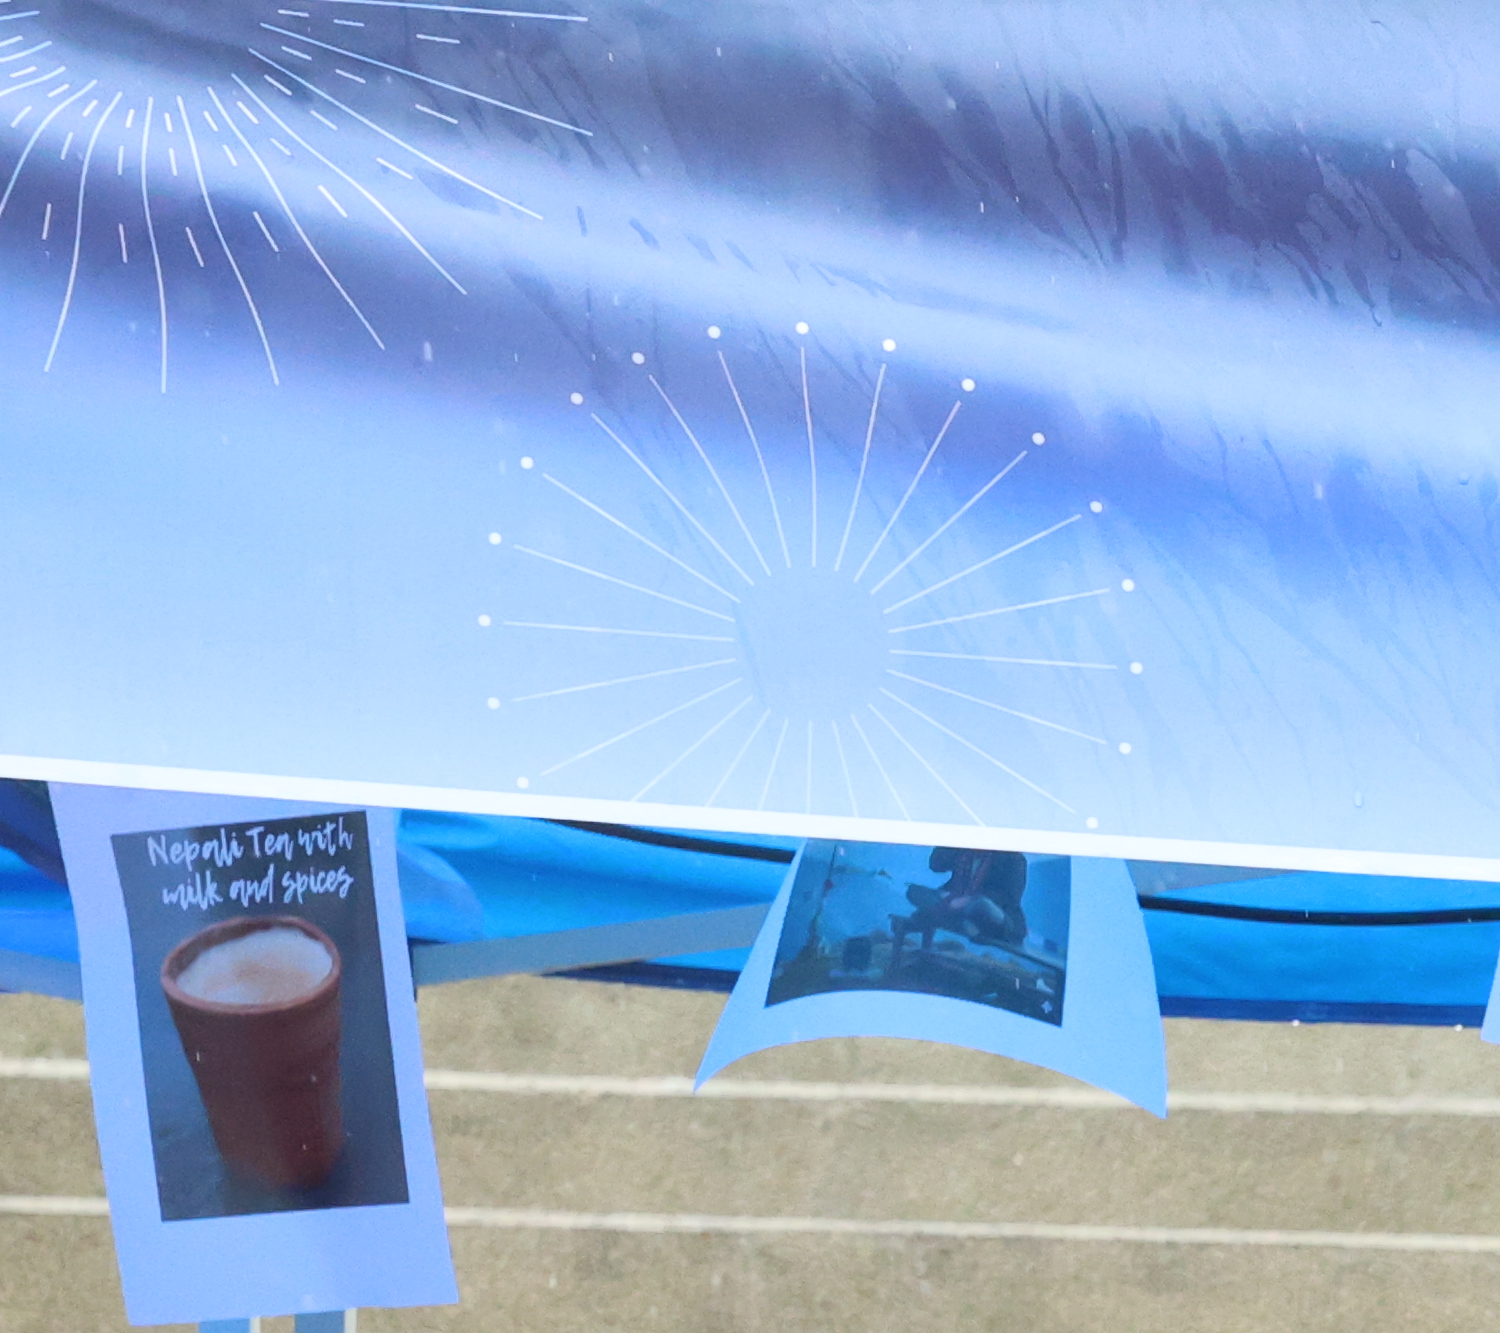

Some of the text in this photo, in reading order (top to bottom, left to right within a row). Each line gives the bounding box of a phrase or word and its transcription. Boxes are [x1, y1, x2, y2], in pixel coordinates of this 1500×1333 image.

[147, 828, 244, 872] Nepali
[298, 816, 353, 857] with
[162, 863, 354, 911] milk and spices
